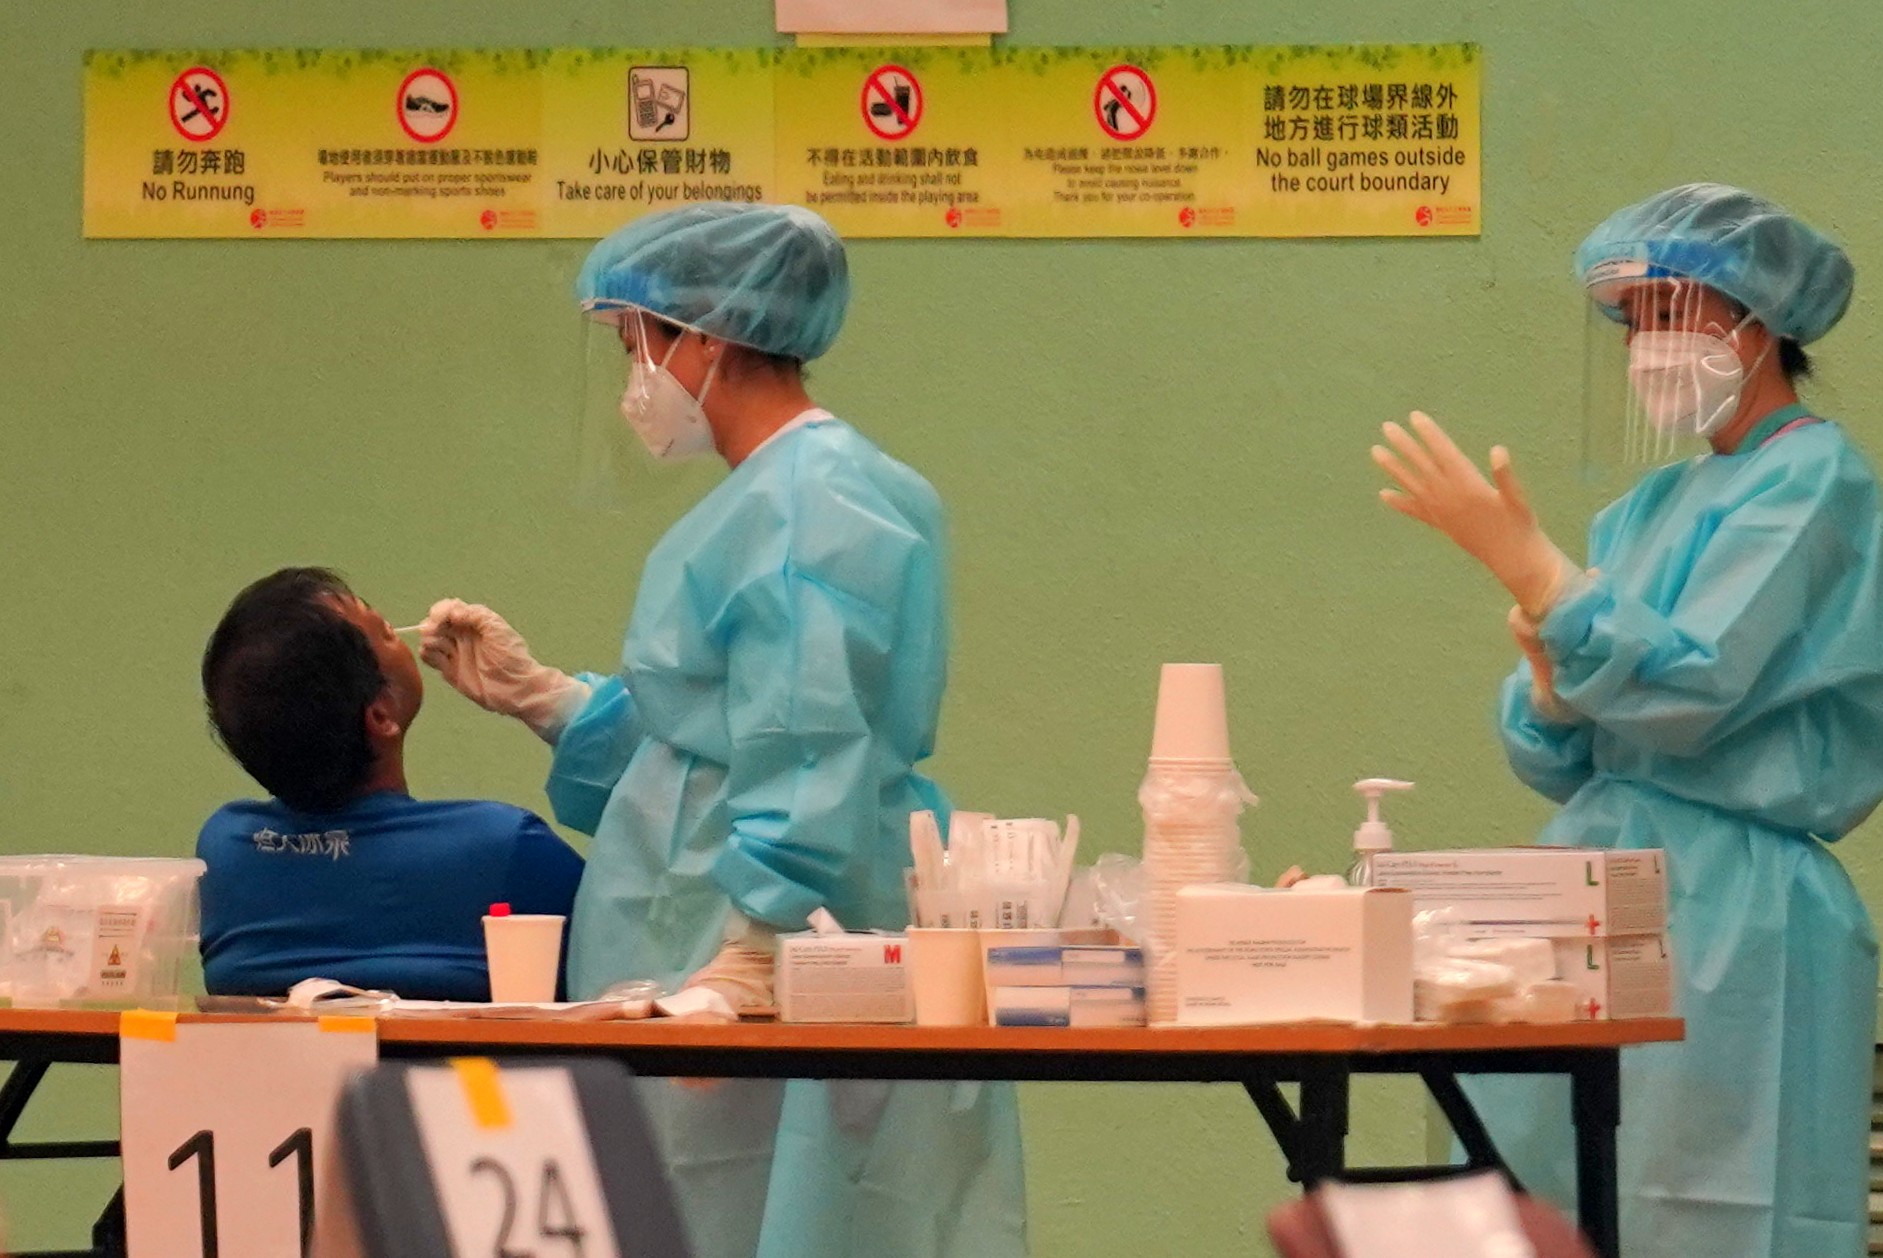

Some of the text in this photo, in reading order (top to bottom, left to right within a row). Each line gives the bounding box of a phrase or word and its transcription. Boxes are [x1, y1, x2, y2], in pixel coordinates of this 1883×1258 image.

[1263, 114, 1459, 141] 地方進行球類活動
[153, 149, 246, 175] 請勿奔跑
[589, 148, 731, 174] 小心保管財物
[1256, 146, 1466, 172] No ball games outside
[919, 170, 943, 185] shall
[1271, 172, 1450, 195] the court boundary
[142, 182, 167, 201] No
[557, 180, 763, 205] Take care of your belongings
[901, 190, 917, 203] the
[918, 191, 954, 206] playing
[1585, 861, 1599, 886] L
[883, 944, 902, 964] M
[1586, 944, 1600, 969] L
[168, 1127, 315, 1258] 11
[469, 1156, 586, 1258] 24
